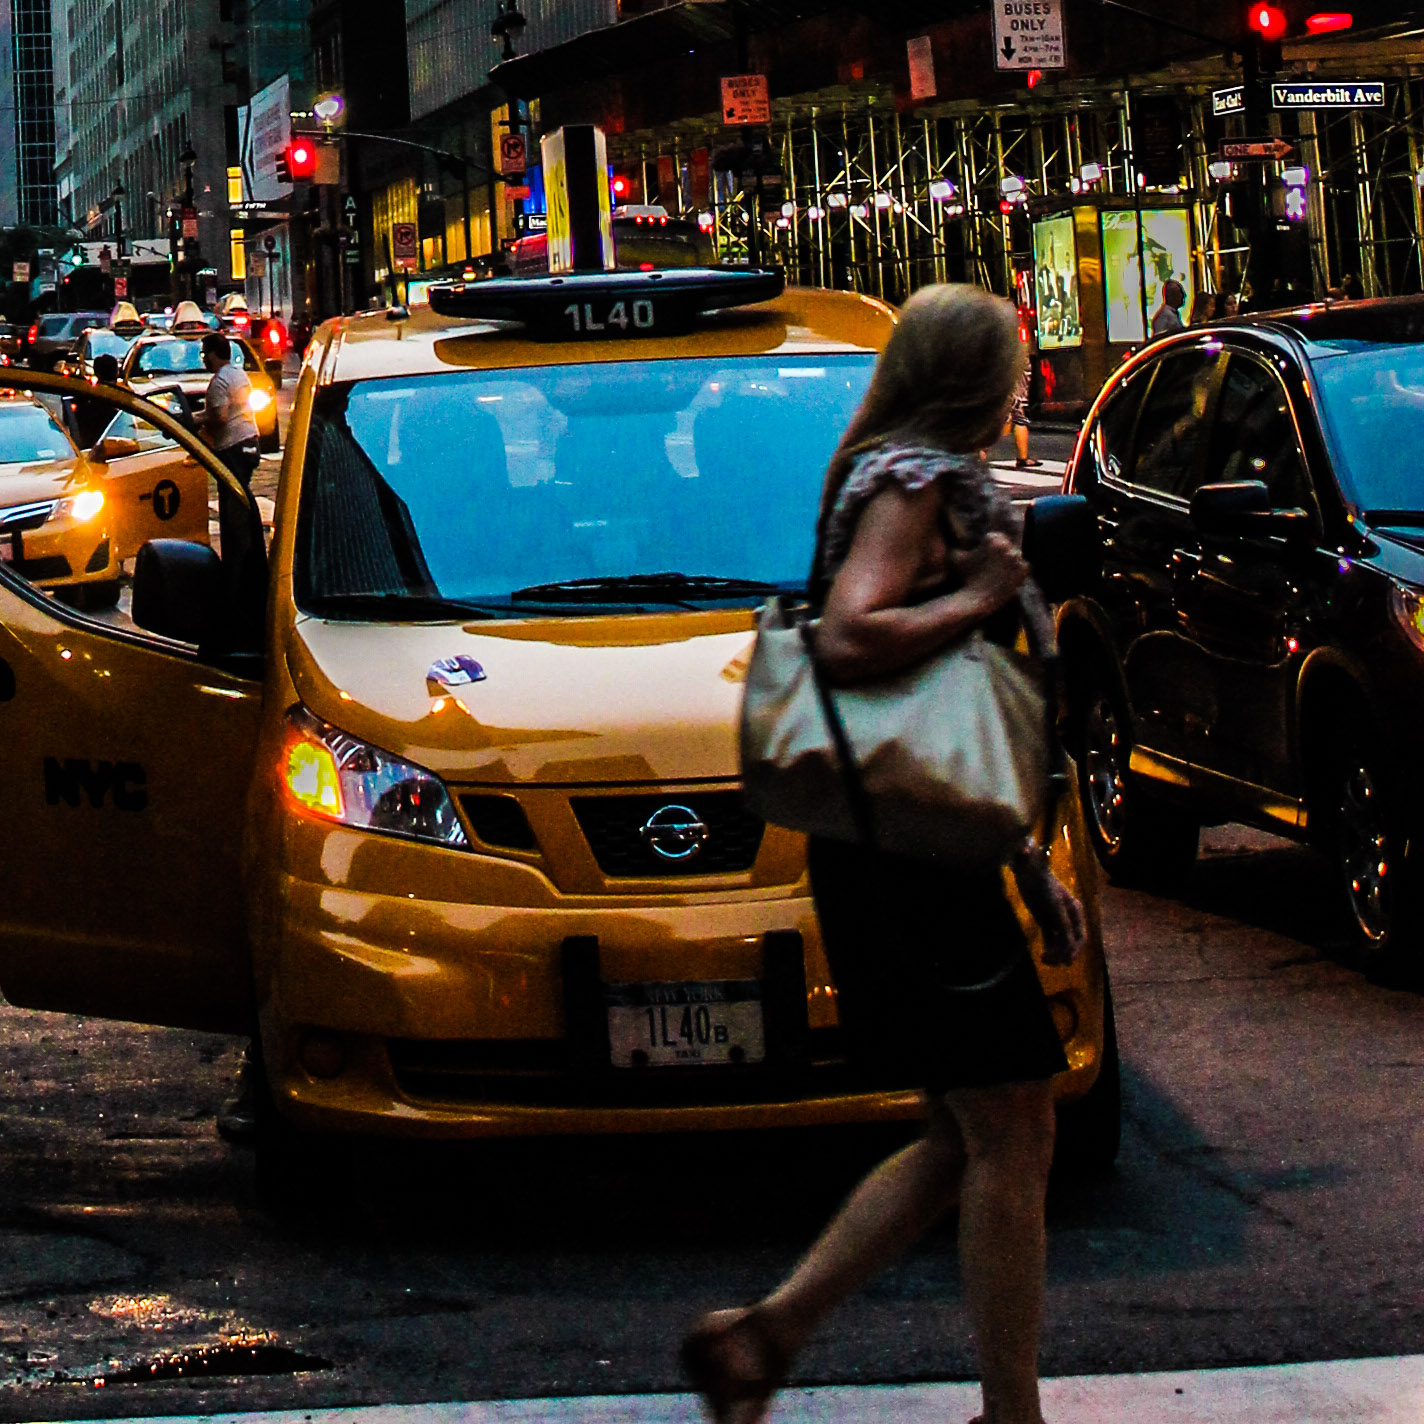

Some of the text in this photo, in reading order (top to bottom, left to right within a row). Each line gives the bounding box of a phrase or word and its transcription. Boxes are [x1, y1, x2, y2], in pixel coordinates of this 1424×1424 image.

[1004, 2, 1051, 15] BUSES
[1010, 19, 1046, 31] ONLY
[1275, 88, 1382, 104] Vanderbilt Ave
[564, 300, 655, 332] 1L40
[44, 757, 146, 811] NYC
